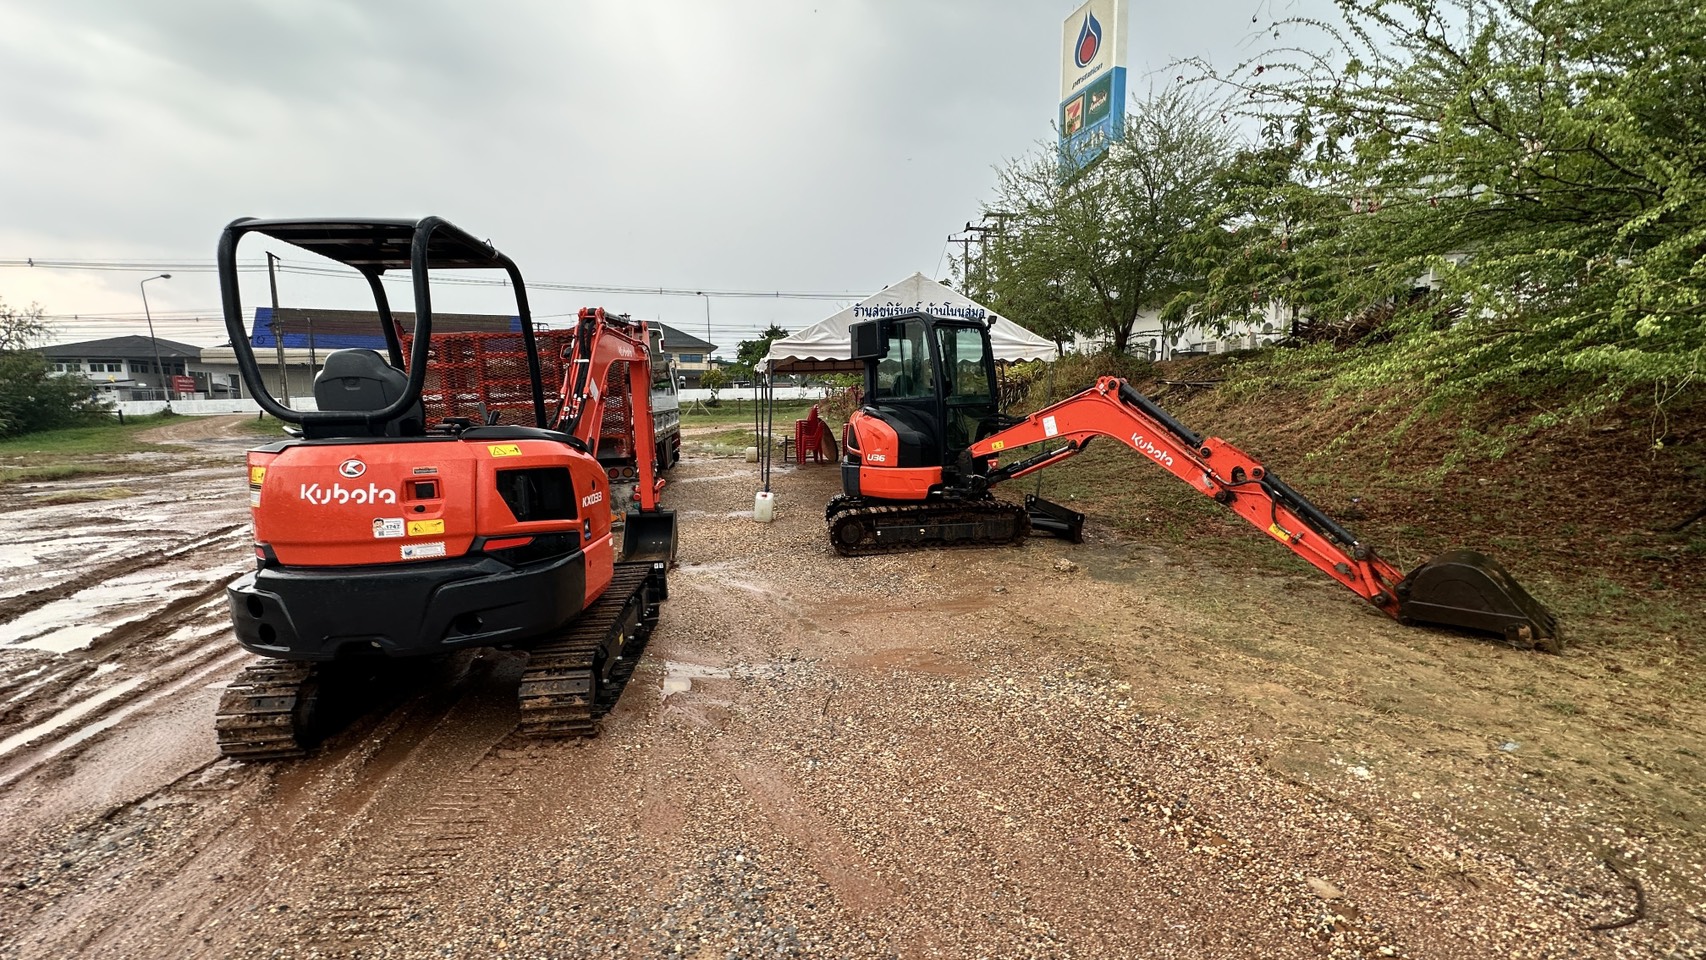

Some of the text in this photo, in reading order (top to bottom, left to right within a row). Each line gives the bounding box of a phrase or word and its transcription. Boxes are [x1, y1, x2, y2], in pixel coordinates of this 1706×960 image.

[867, 453, 886, 462] U36
[1131, 432, 1174, 467] Kubota
[300, 482, 397, 505] Kubota
